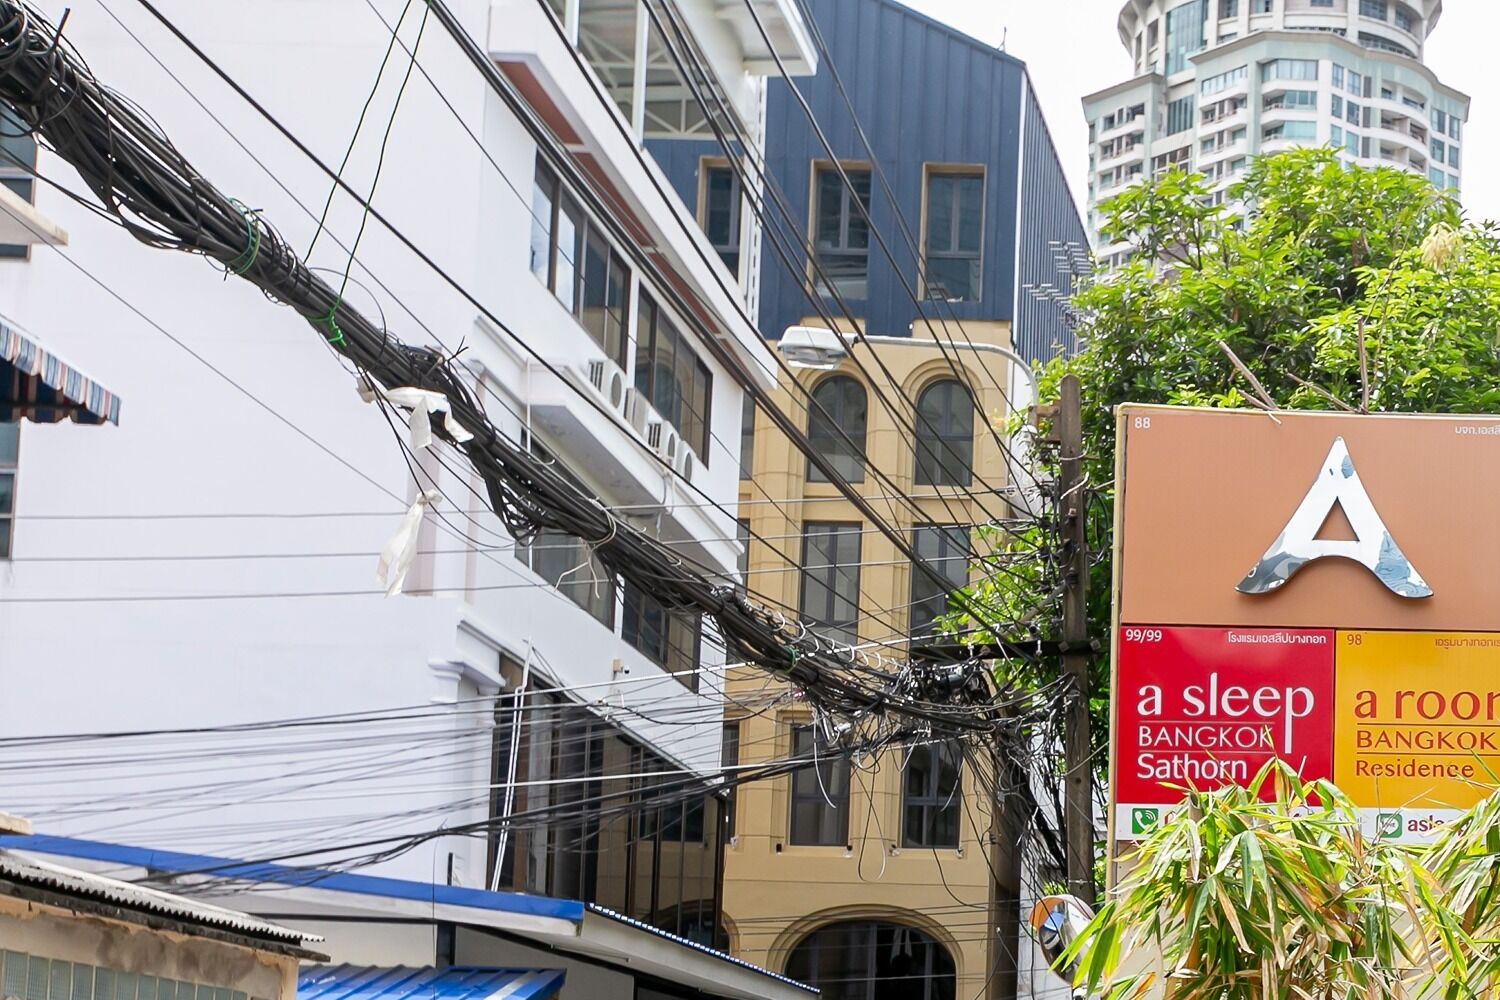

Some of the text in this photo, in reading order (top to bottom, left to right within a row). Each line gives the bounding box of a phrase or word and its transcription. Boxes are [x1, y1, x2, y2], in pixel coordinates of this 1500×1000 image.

[1134, 416, 1151, 429] 88
[1234, 435, 1435, 600] A
[1125, 629, 1163, 644] 99/99
[1346, 633, 1362, 646] 98
[1137, 672, 1315, 754] a sleep
[1354, 690, 1377, 719] a
[1138, 726, 1273, 748] BANGKOK
[1356, 730, 1498, 751] BANGKOK
[1136, 753, 1248, 780] Sathorn
[1355, 758, 1475, 778] Residence
